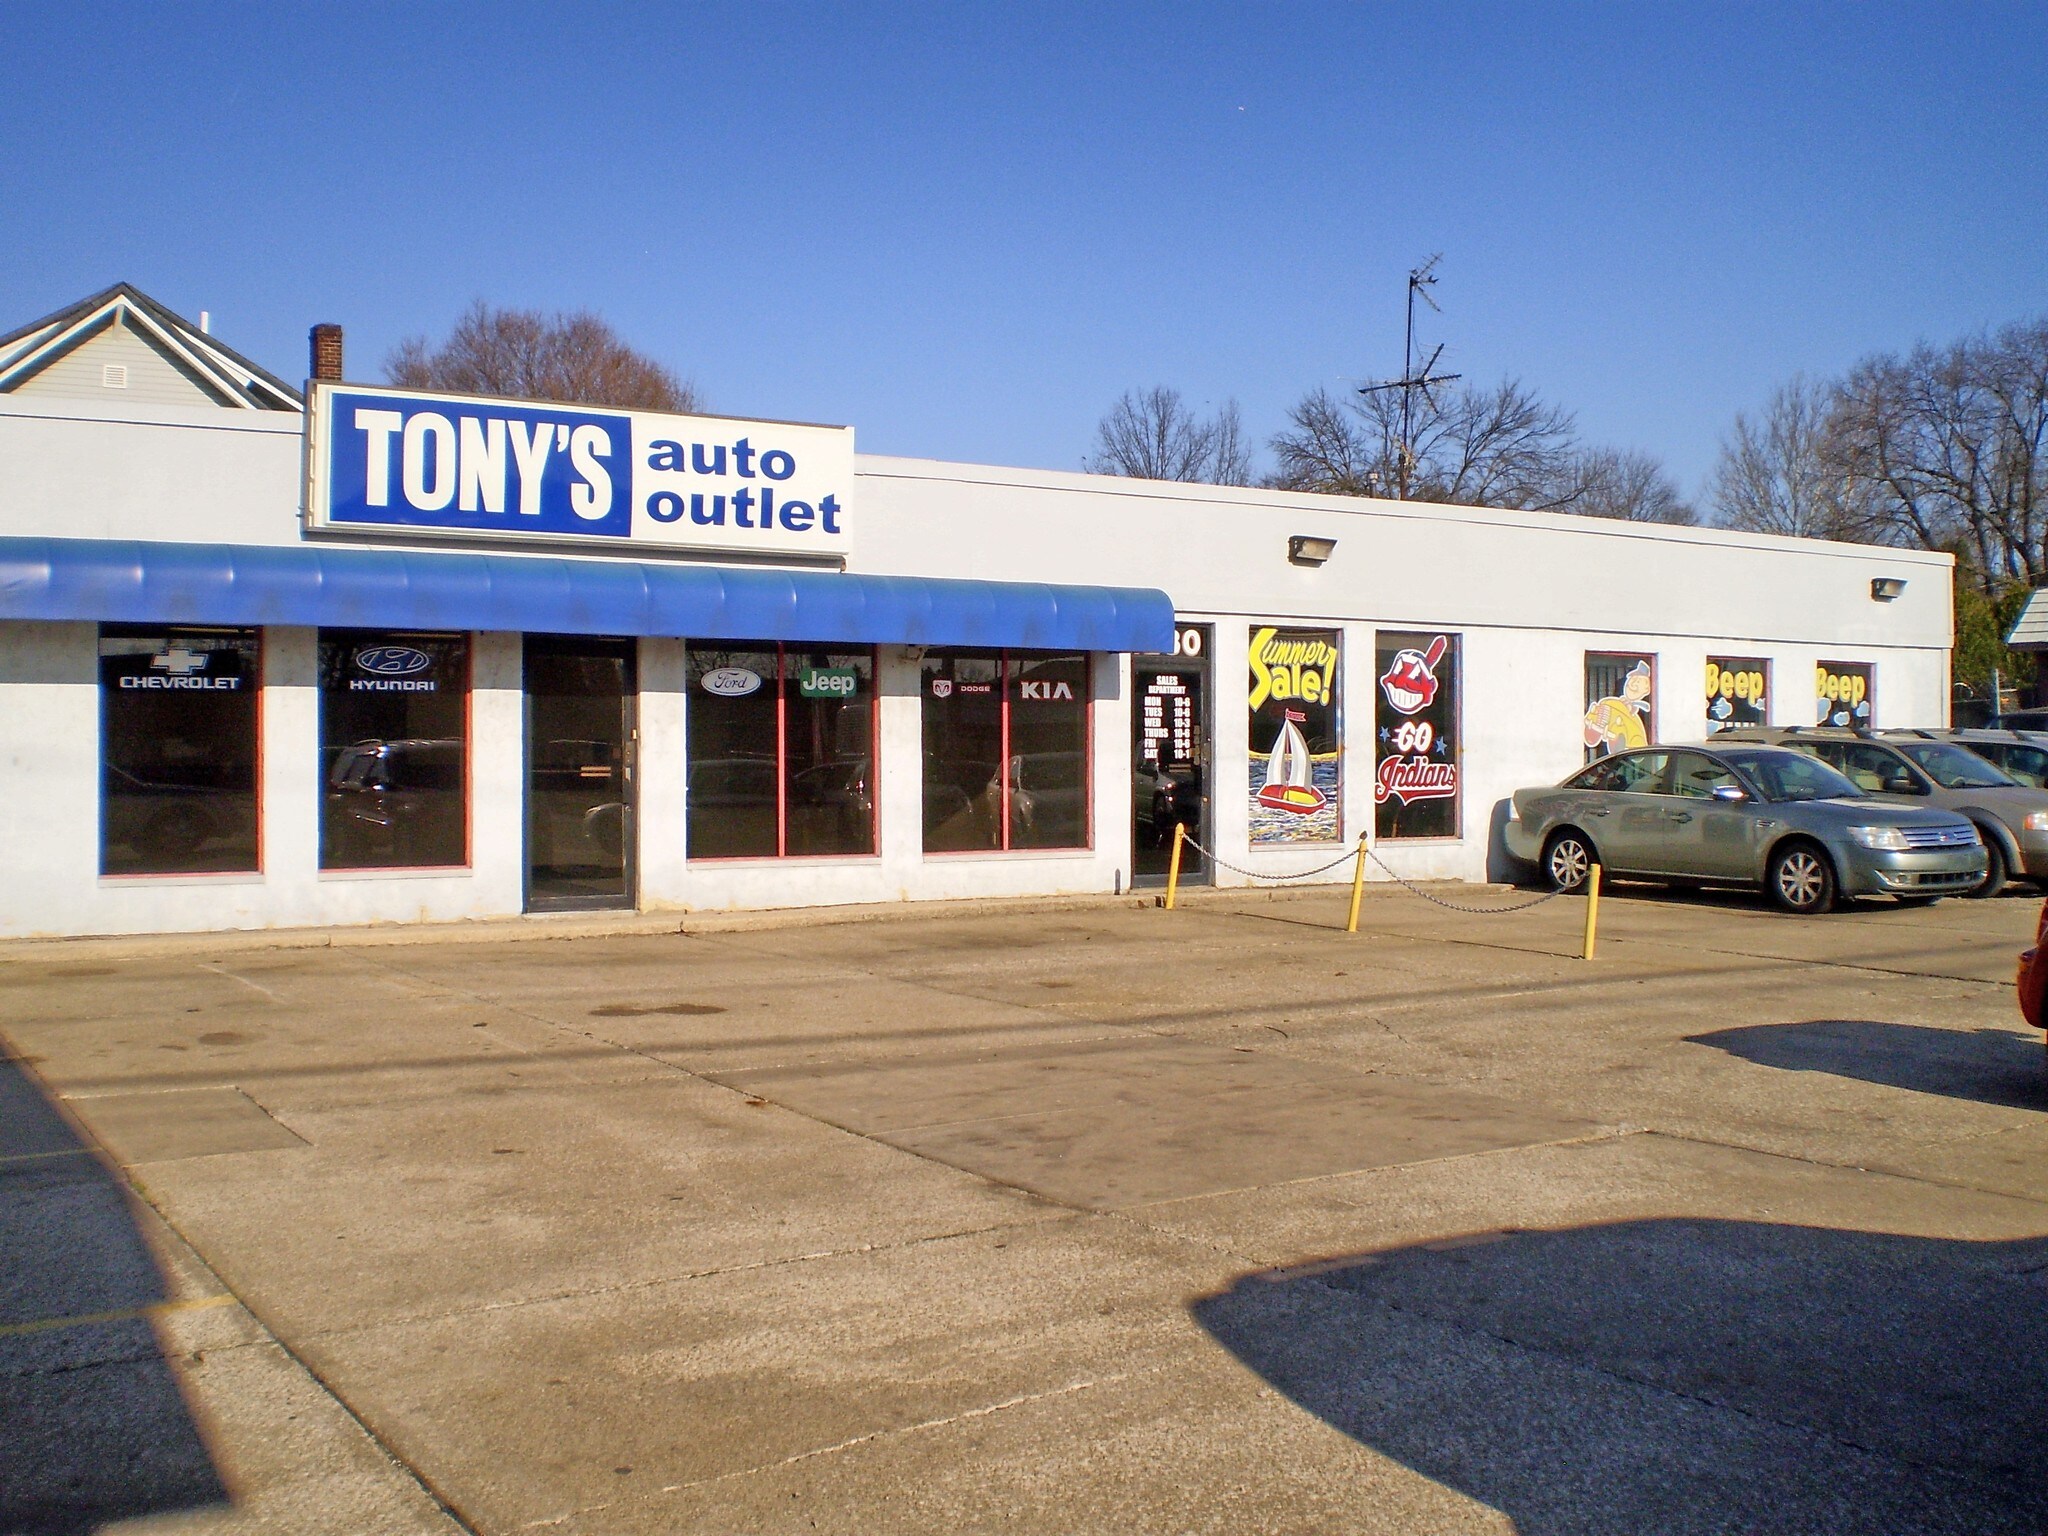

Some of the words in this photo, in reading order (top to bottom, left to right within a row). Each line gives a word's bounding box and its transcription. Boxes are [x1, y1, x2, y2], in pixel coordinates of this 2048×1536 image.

[355, 408, 613, 521] TONY'S
[646, 437, 796, 481] auto
[646, 487, 842, 534] outlet
[119, 676, 239, 689] CHEVROLET
[350, 680, 435, 691] HYUNDAI
[714, 673, 748, 690] Ford
[803, 671, 855, 694] Jeep
[1157, 676, 1178, 686] SALES
[1706, 663, 1764, 706] Beep
[1816, 667, 1866, 708] Beep
[961, 685, 991, 693] DODGE
[1021, 681, 1073, 699] KIA
[1149, 686, 1186, 694] DEPARTMENT
[1144, 696, 1162, 707] MON
[1144, 707, 1163, 718] TUES
[1144, 717, 1162, 728] WED
[1144, 728, 1169, 739] THURS
[1392, 721, 1433, 752] GO
[1144, 738, 1157, 749] FRI
[1144, 748, 1158, 759] SAT
[1174, 749, 1190, 759] 10-1
[1375, 754, 1456, 806] Indians
